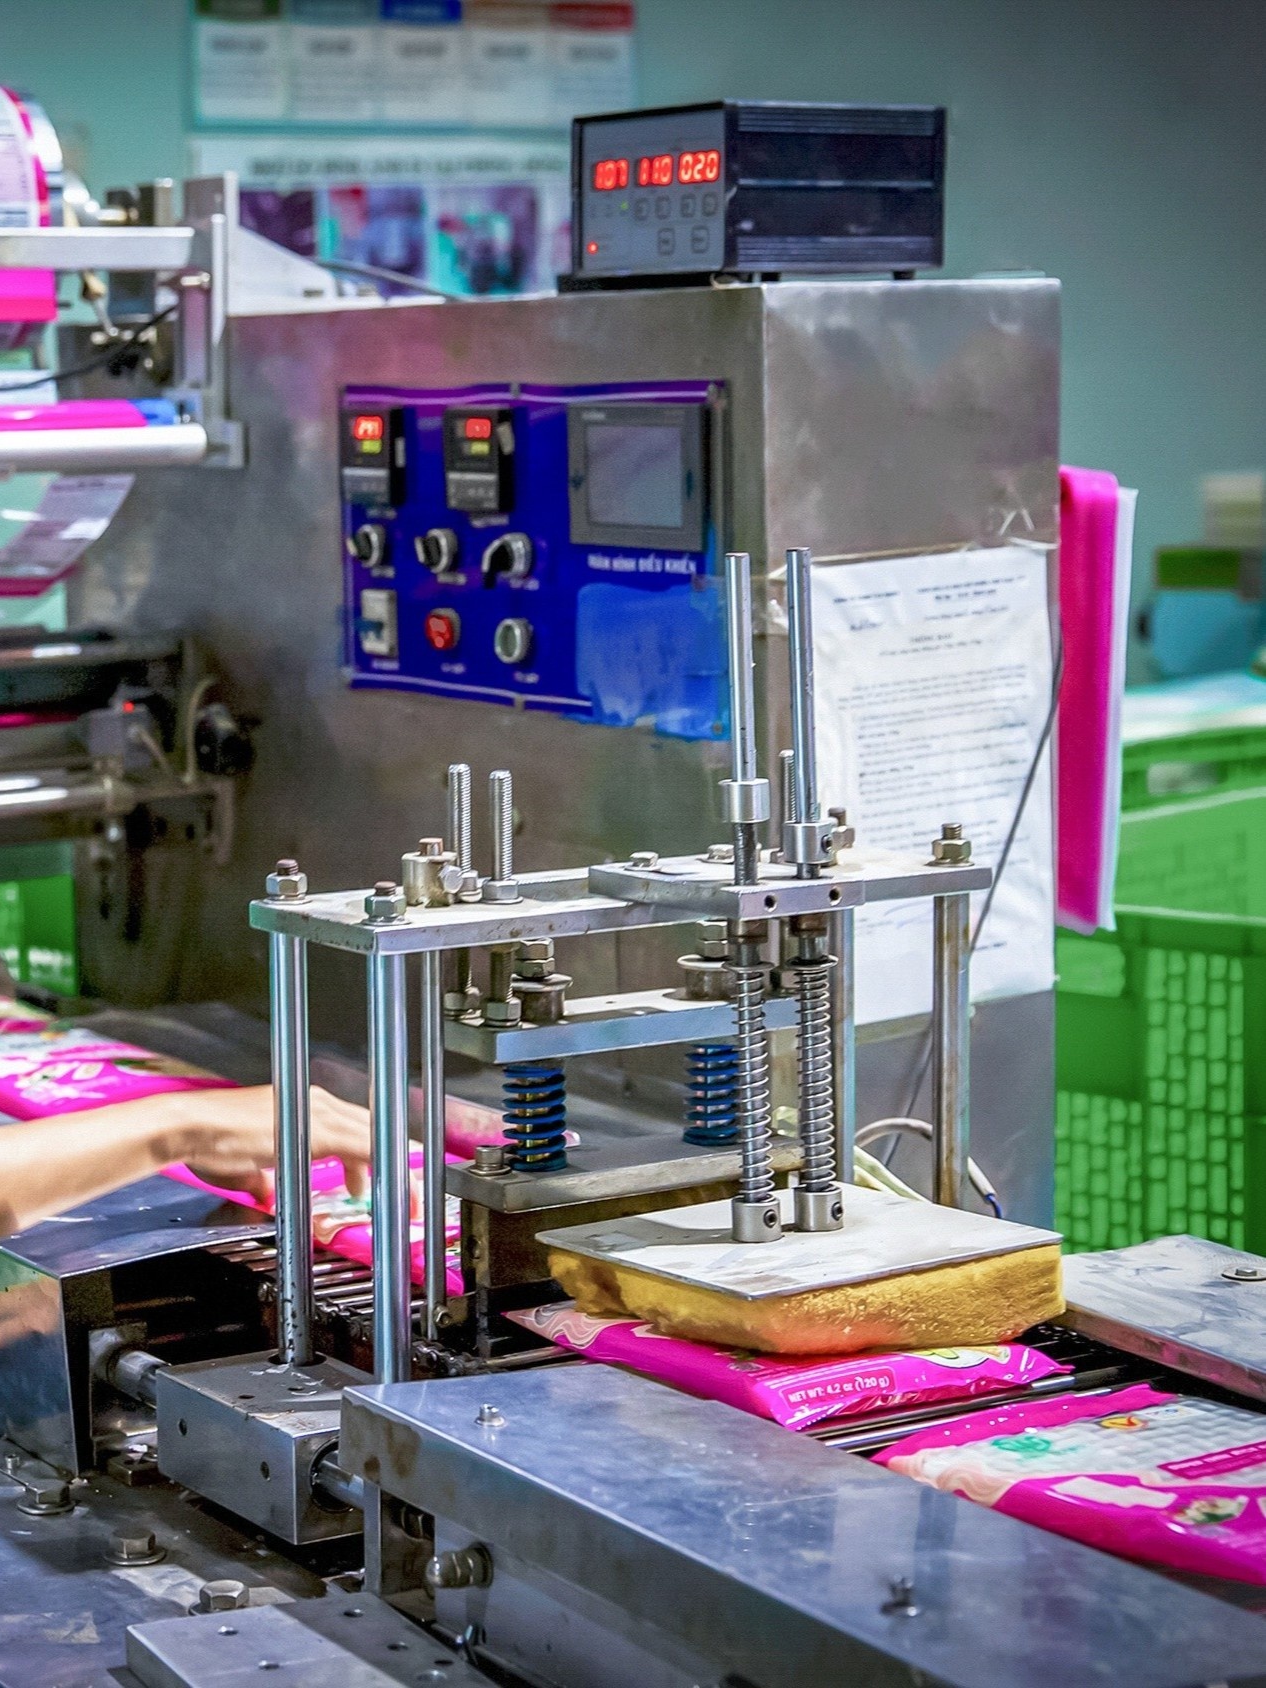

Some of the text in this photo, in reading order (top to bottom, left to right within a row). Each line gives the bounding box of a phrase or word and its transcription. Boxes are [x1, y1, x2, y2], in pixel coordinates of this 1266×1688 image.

[640, 155, 672, 185] 110
[679, 150, 719, 183] 020
[789, 1391, 807, 1402] NET
[827, 1384, 841, 1394] 4.2
[842, 1382, 853, 1392] oz
[855, 1377, 877, 1391] (120
[878, 1375, 890, 1388] g)
